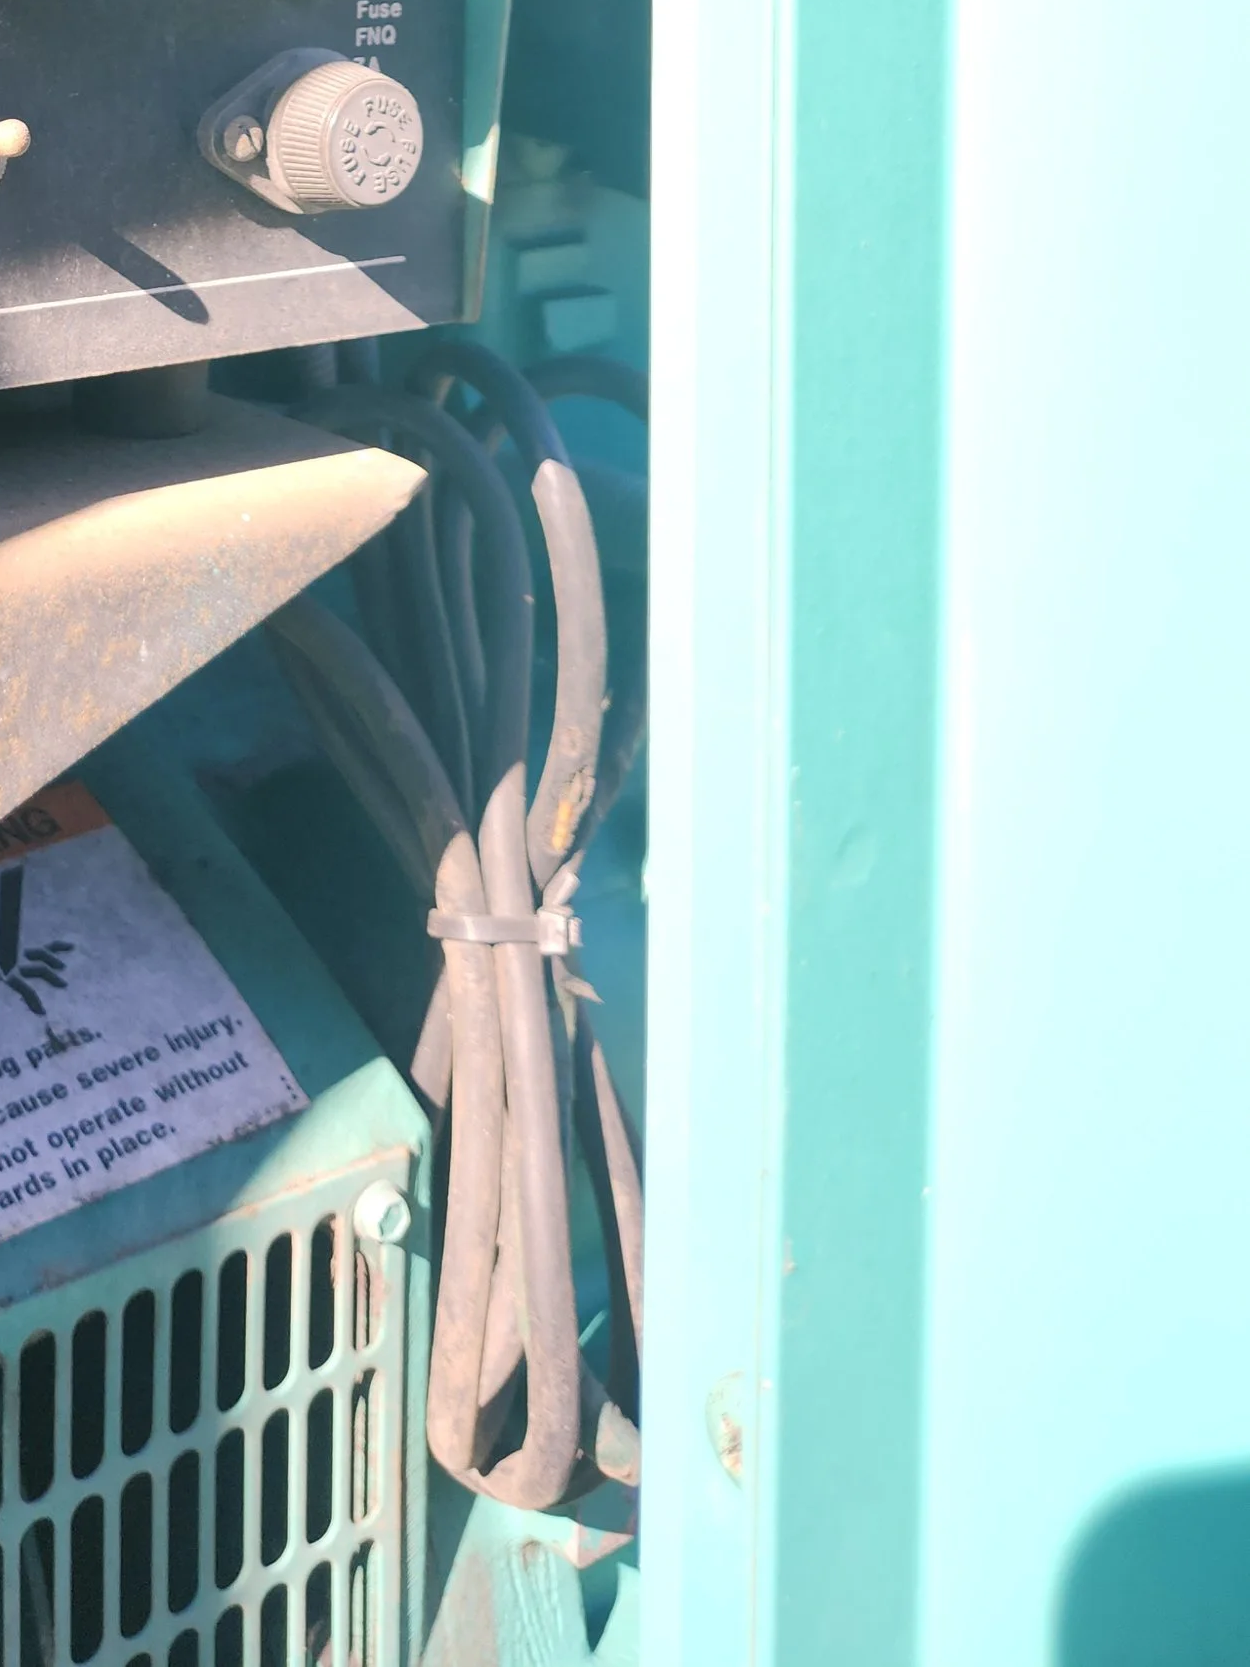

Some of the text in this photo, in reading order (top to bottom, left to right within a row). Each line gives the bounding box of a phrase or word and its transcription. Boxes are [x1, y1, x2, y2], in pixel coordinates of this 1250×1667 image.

[356, 0, 402, 19] Fuse
[355, 25, 397, 46] FNQ
[362, 94, 412, 131] FUSE
[76, 1045, 161, 1089] severe
[163, 1014, 243, 1053] injury.
[47, 1095, 147, 1149] operate
[153, 1050, 249, 1103] without
[60, 1157, 91, 1180] in
[97, 1122, 176, 1171] place.
